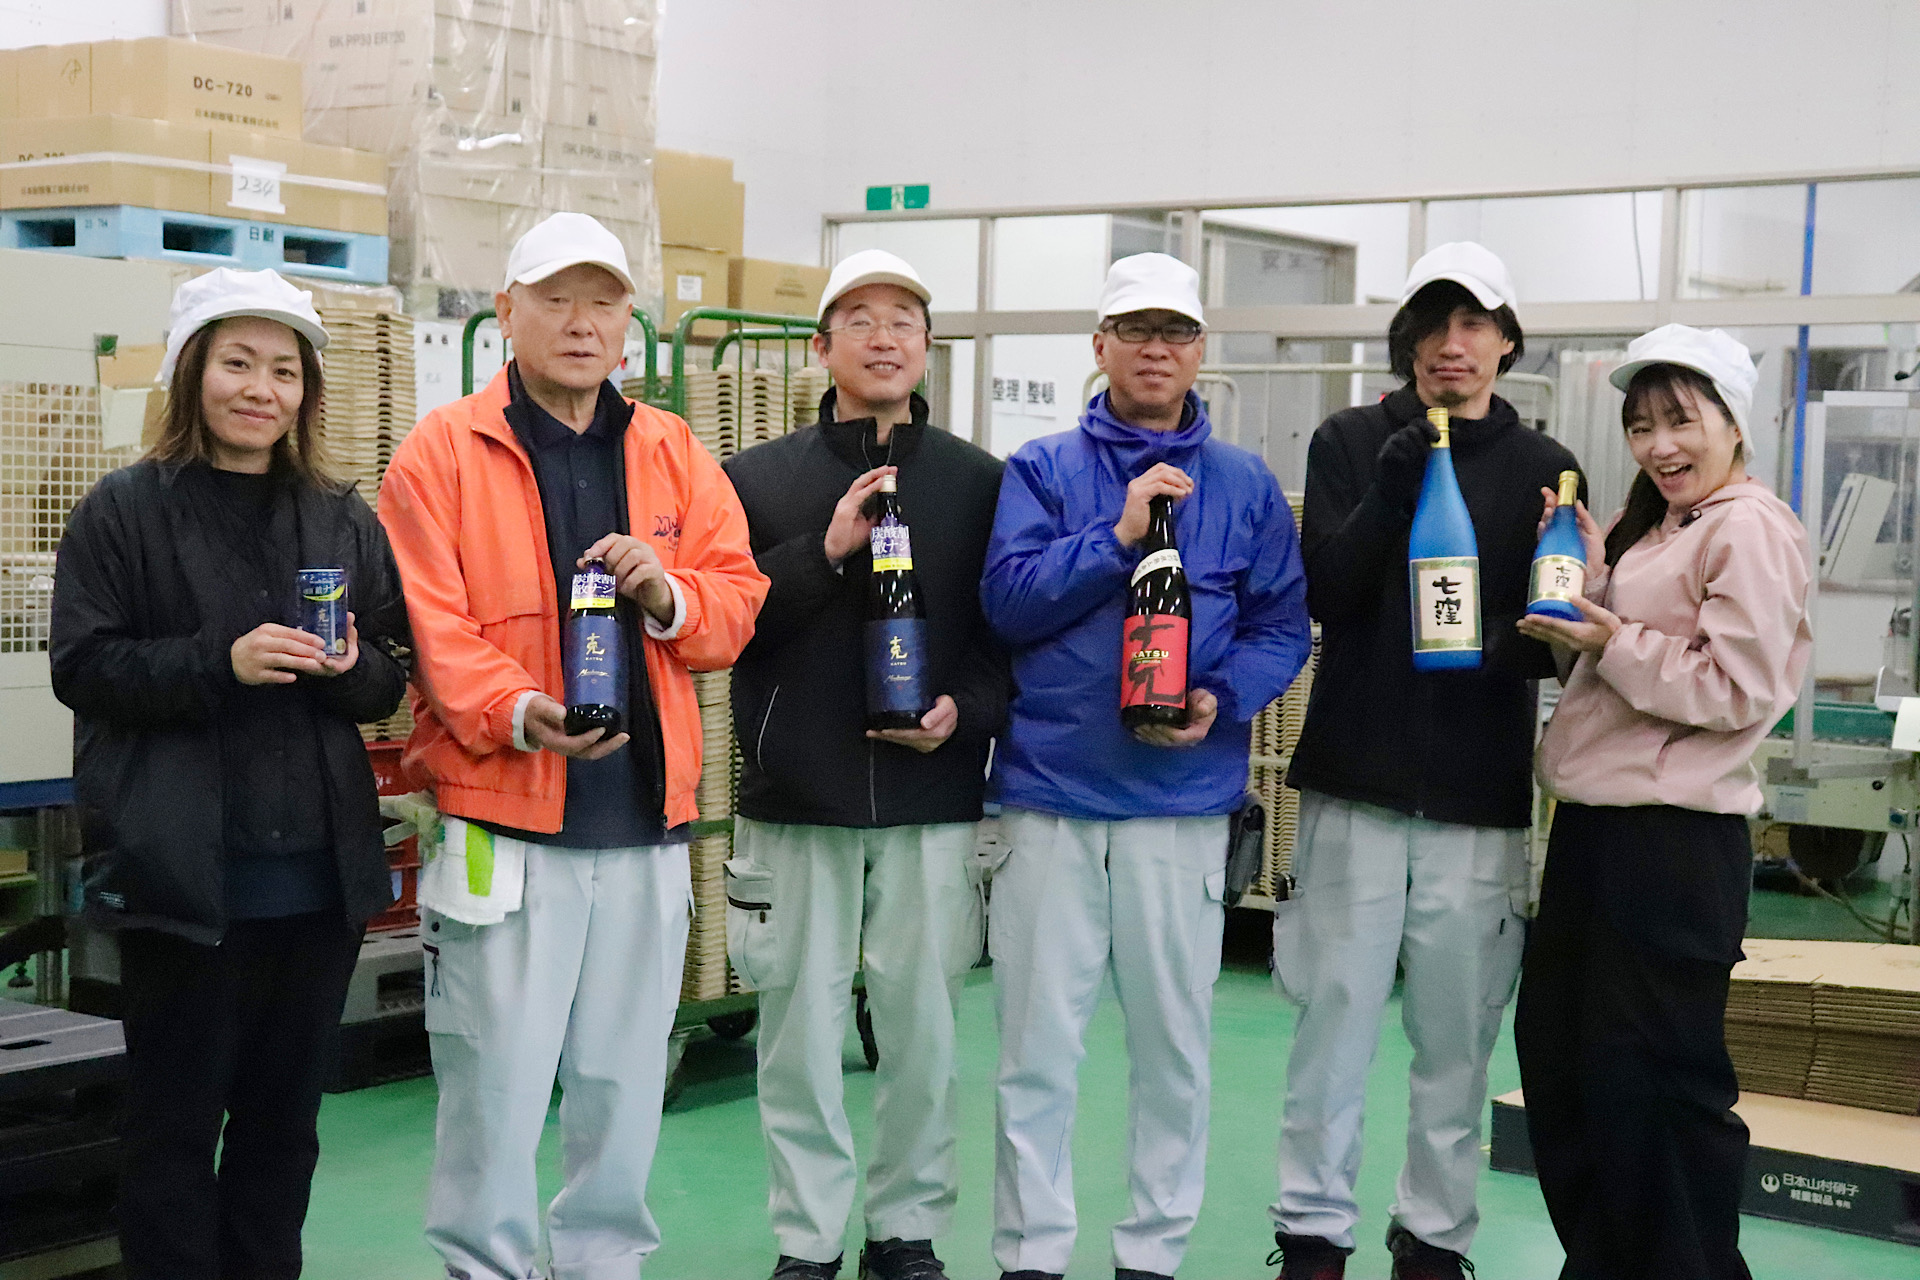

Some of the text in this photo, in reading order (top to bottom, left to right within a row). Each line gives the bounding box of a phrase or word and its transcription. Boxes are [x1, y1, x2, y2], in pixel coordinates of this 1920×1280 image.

[193, 76, 253, 97] DC-720
[238, 175, 274, 197] 234
[1432, 576, 1463, 626] 七窪
[585, 632, 606, 655] 克
[889, 635, 908, 660] 克
[1132, 650, 1169, 658] KATSU
[1783, 1173, 1860, 1197] 日本山村硝子
